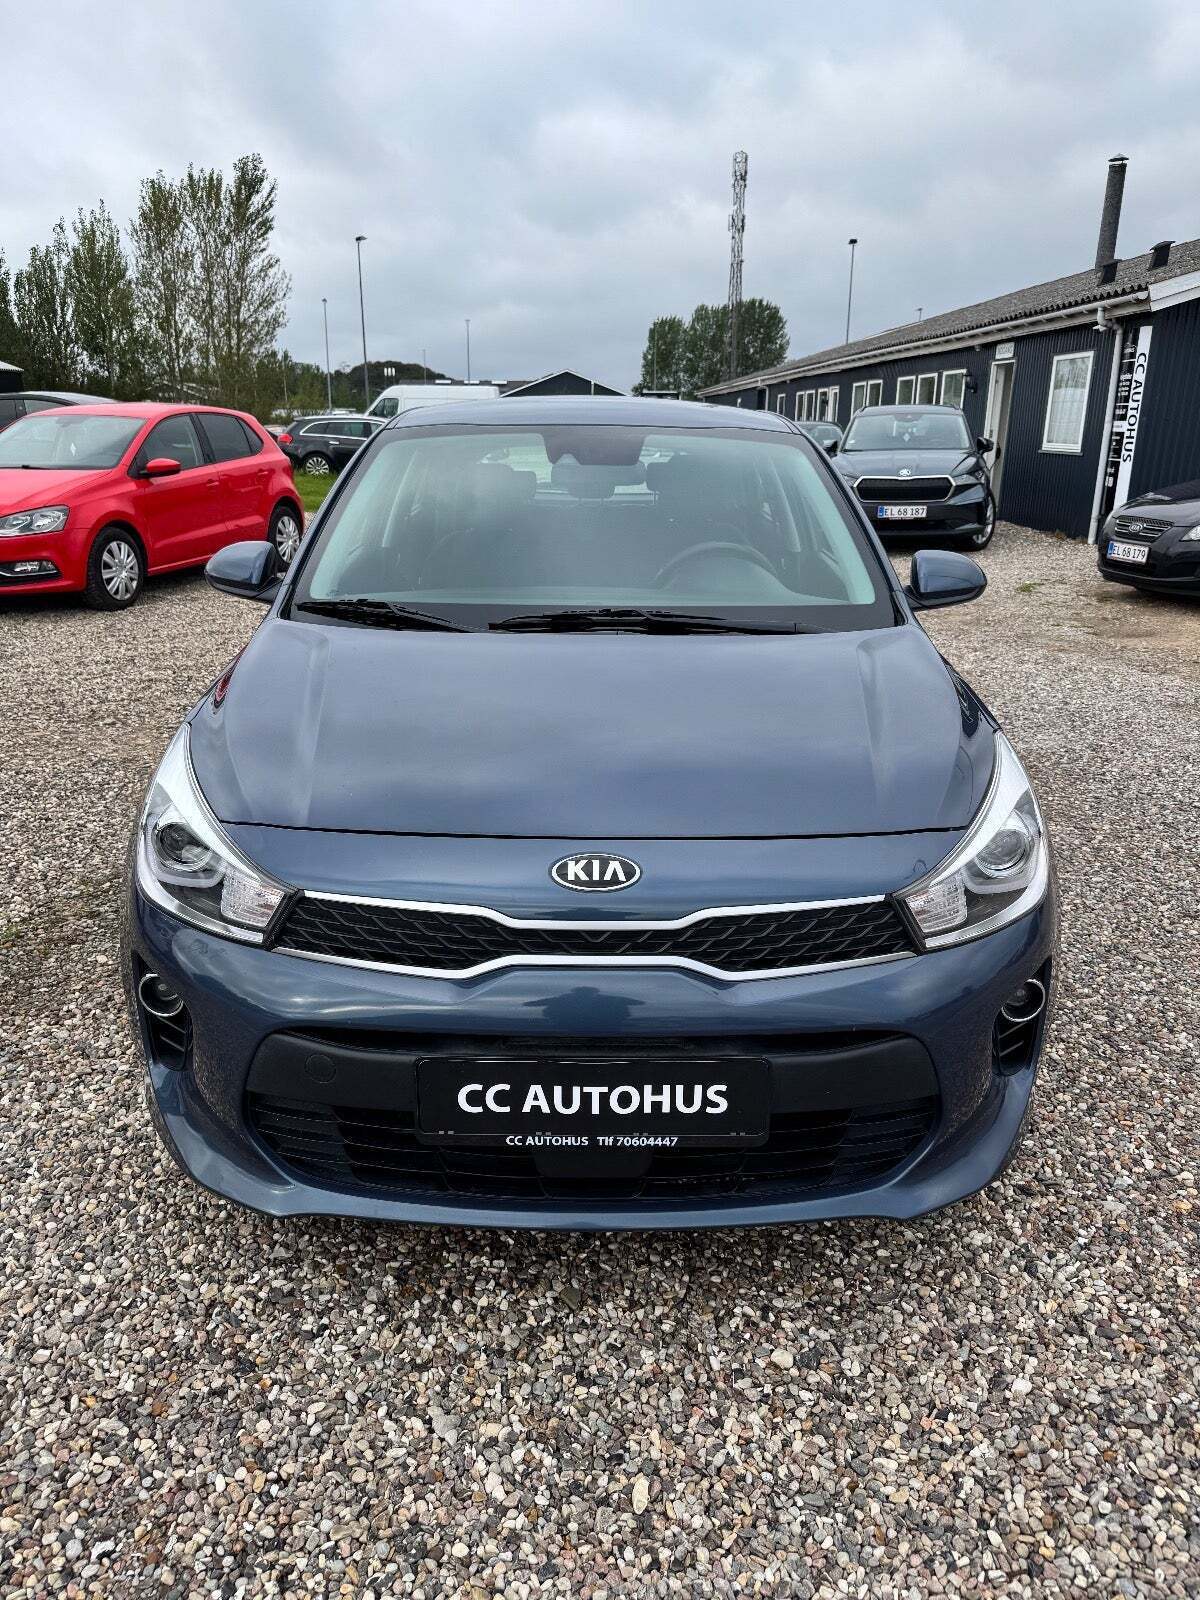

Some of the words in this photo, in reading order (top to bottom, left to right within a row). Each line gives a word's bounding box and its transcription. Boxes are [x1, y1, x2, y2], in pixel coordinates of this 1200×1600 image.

[1135, 353, 1147, 374] CC
[1122, 380, 1142, 462] AUTOHUS
[884, 507, 895, 517] EL
[897, 507, 908, 517] 68
[910, 507, 925, 517] 187
[1112, 545, 1121, 556] EL
[1122, 546, 1131, 558] 68
[1132, 548, 1146, 559] 179
[567, 859, 626, 881] KIA
[457, 1083, 511, 1113] CC
[521, 1084, 728, 1115] AUTOHUS
[505, 1135, 523, 1146] CC
[525, 1136, 589, 1146] AUTOHUS
[597, 1136, 614, 1146] Tlf
[616, 1136, 679, 1147] 70604447
